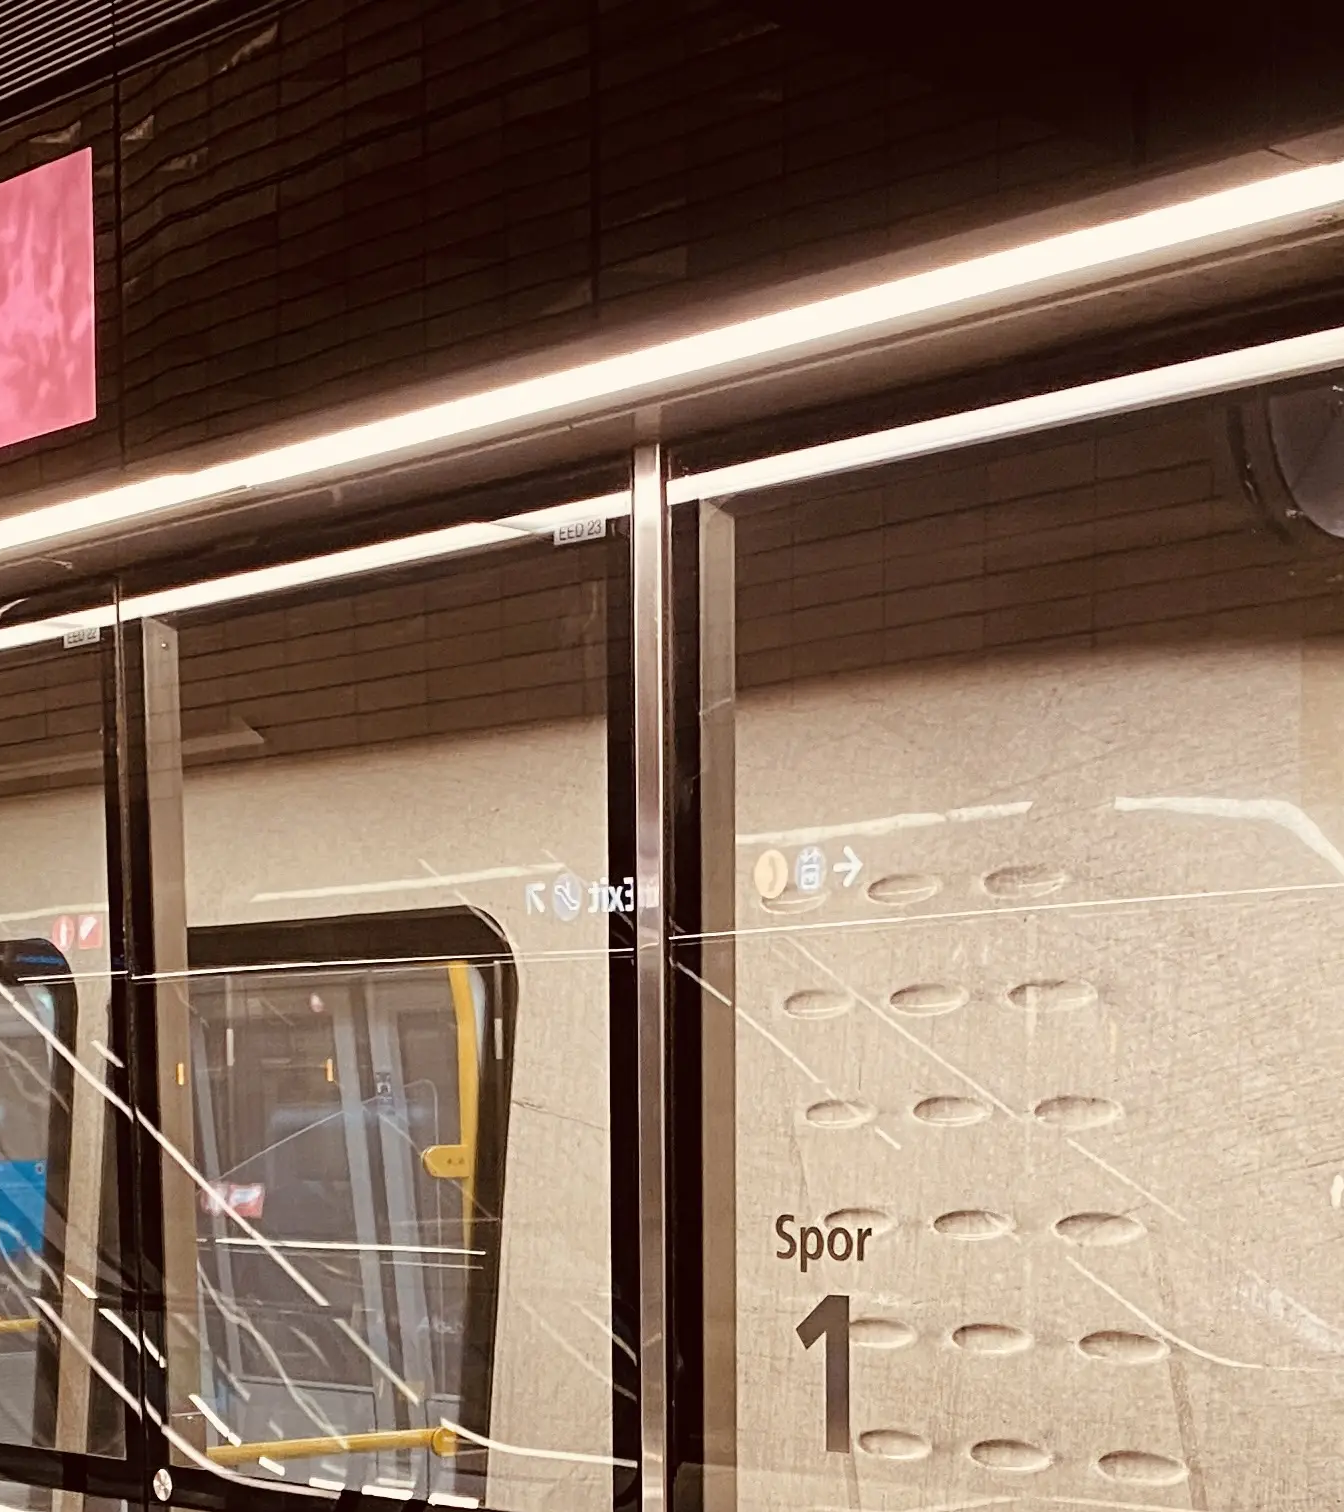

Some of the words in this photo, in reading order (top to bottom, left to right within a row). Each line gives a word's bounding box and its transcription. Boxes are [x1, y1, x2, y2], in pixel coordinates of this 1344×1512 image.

[559, 522, 584, 542] EED
[587, 518, 602, 537] 23
[775, 1214, 872, 1272] Spor
[796, 1294, 850, 1453] 1
